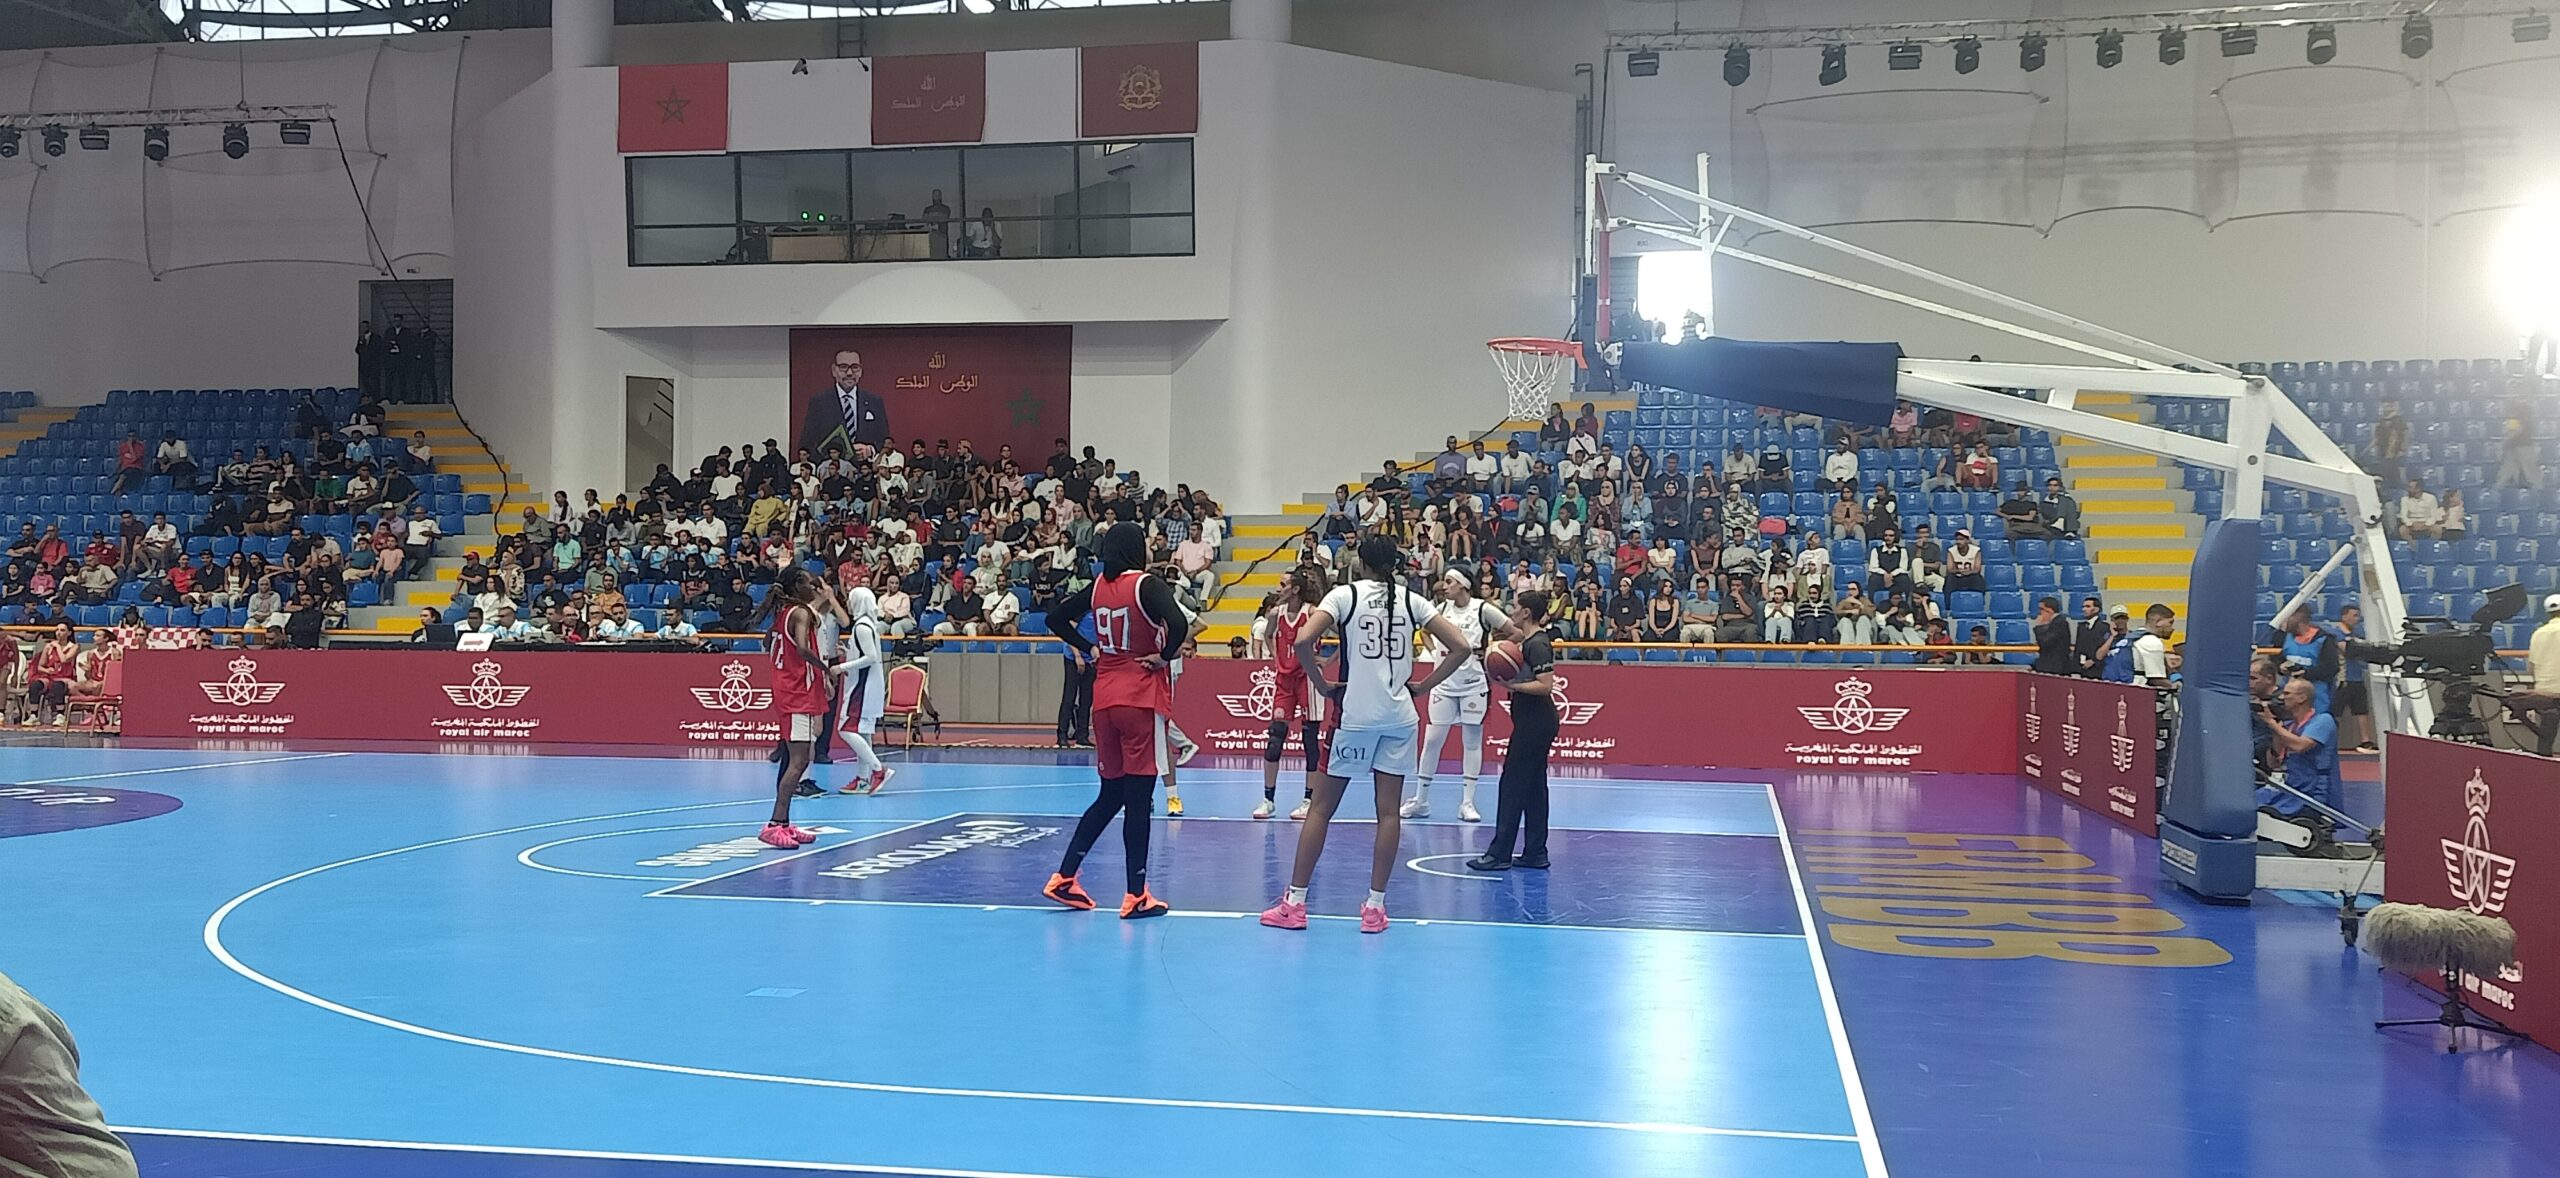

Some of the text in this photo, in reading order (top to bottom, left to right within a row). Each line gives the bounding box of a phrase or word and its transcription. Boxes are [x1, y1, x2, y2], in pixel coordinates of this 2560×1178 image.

[928, 351, 946, 369] الله
[895, 374, 978, 393] الوطن الملك
[1095, 606, 1130, 656] 97
[1359, 614, 1406, 660] 35
[197, 725, 285, 733] royal air maroc
[440, 728, 530, 737] royal air maroc
[688, 731, 719, 740] royal
[723, 732, 740, 740] air
[1215, 740, 1248, 750] royal
[1561, 749, 1604, 758] maroc
[1796, 755, 1911, 765] royal air maroc
